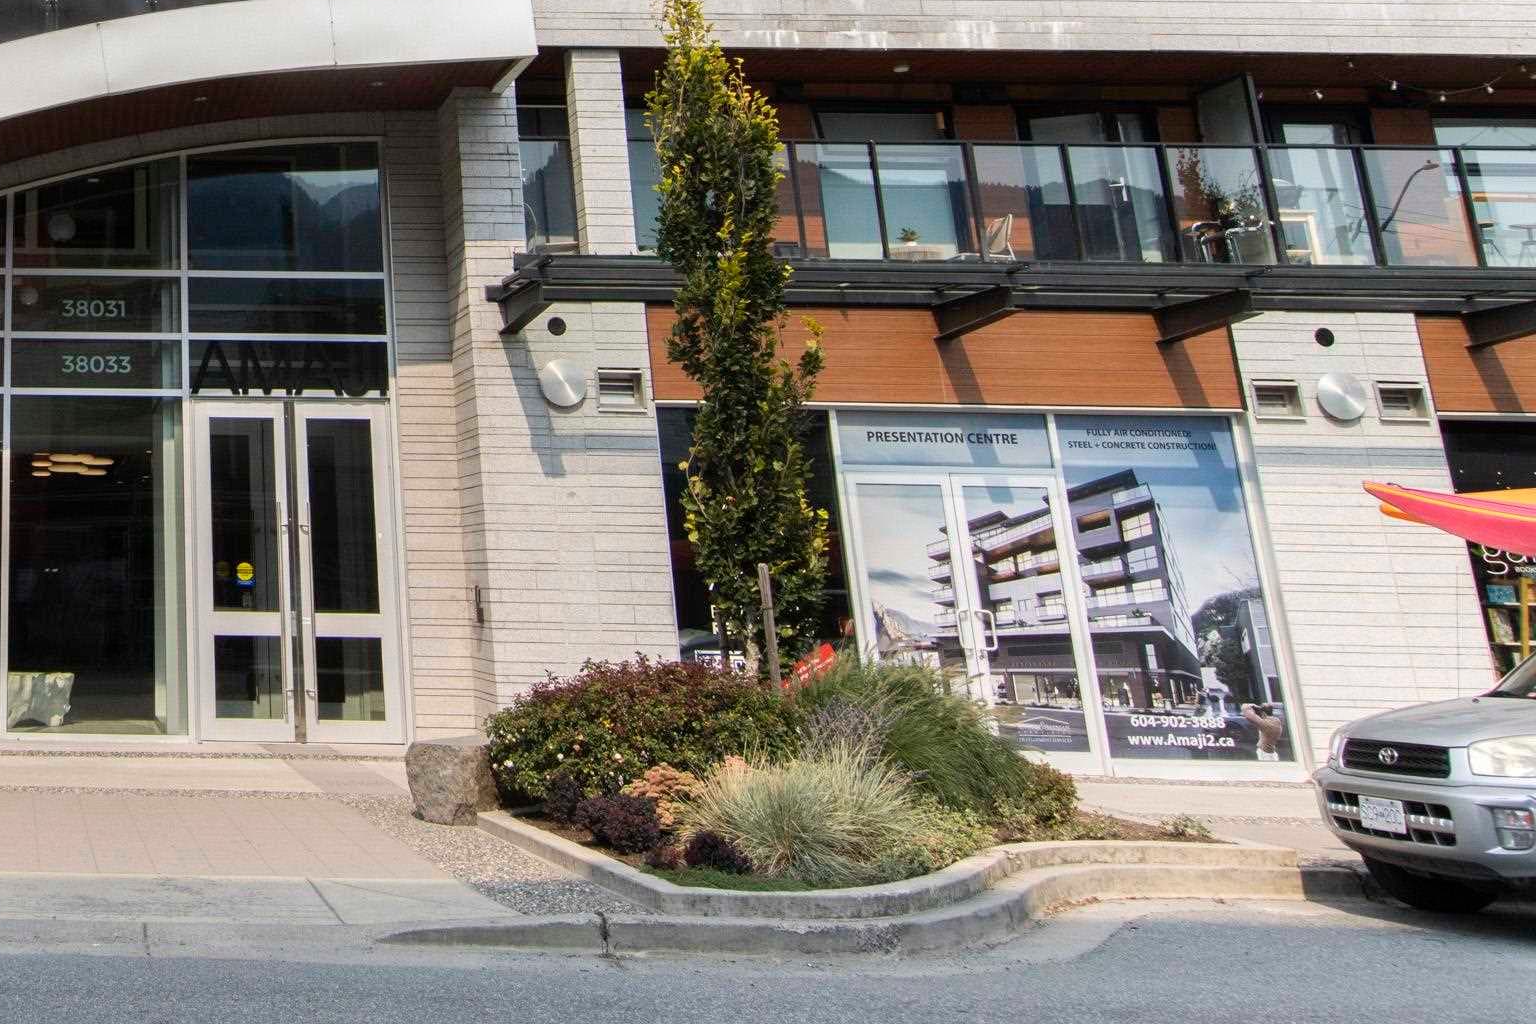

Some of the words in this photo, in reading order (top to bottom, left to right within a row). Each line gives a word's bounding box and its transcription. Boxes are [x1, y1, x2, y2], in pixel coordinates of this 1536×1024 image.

[62, 299, 126, 317] 38031
[62, 355, 131, 373] 38033
[866, 430, 964, 444] PRESENTATION
[967, 432, 1018, 445] CENTRE
[1086, 429, 1111, 437] FULLY
[1114, 429, 1127, 437] AIR
[1068, 441, 1092, 449] STEEL
[1102, 441, 1147, 450] CONCRETE
[1130, 716, 1226, 728] 604-902-3888
[1127, 733, 1235, 749] www.Amaji2.ca
